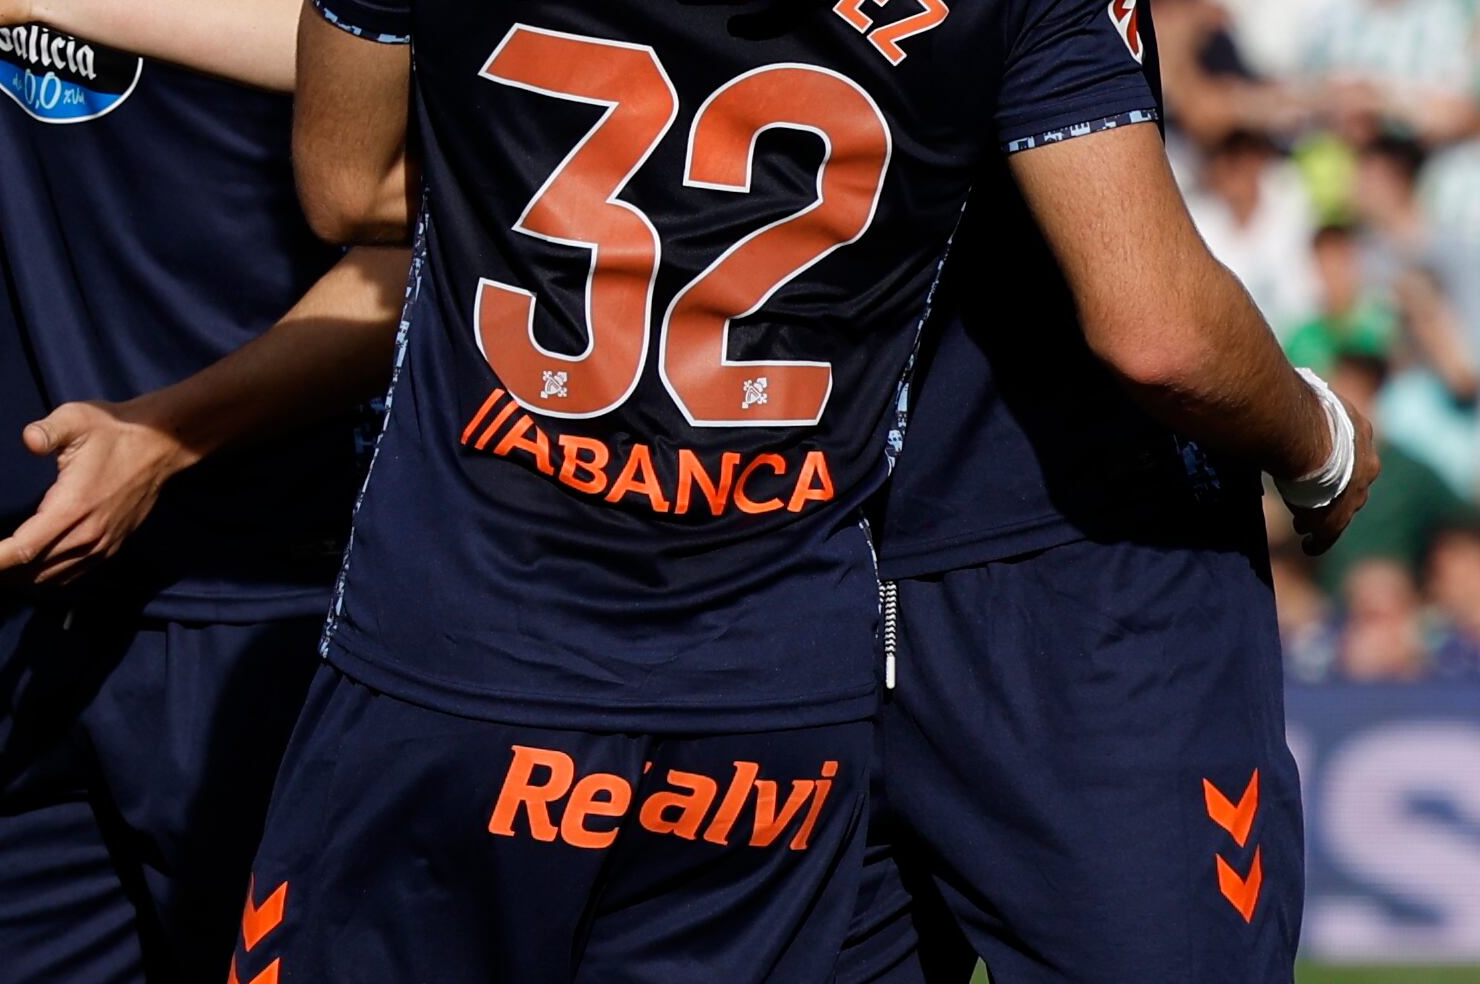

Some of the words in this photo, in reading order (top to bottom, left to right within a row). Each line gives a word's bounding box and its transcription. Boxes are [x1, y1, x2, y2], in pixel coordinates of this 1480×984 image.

[473, 22, 893, 427] 32
[460, 388, 835, 516] ABANCA
[487, 744, 839, 851] Realvi
